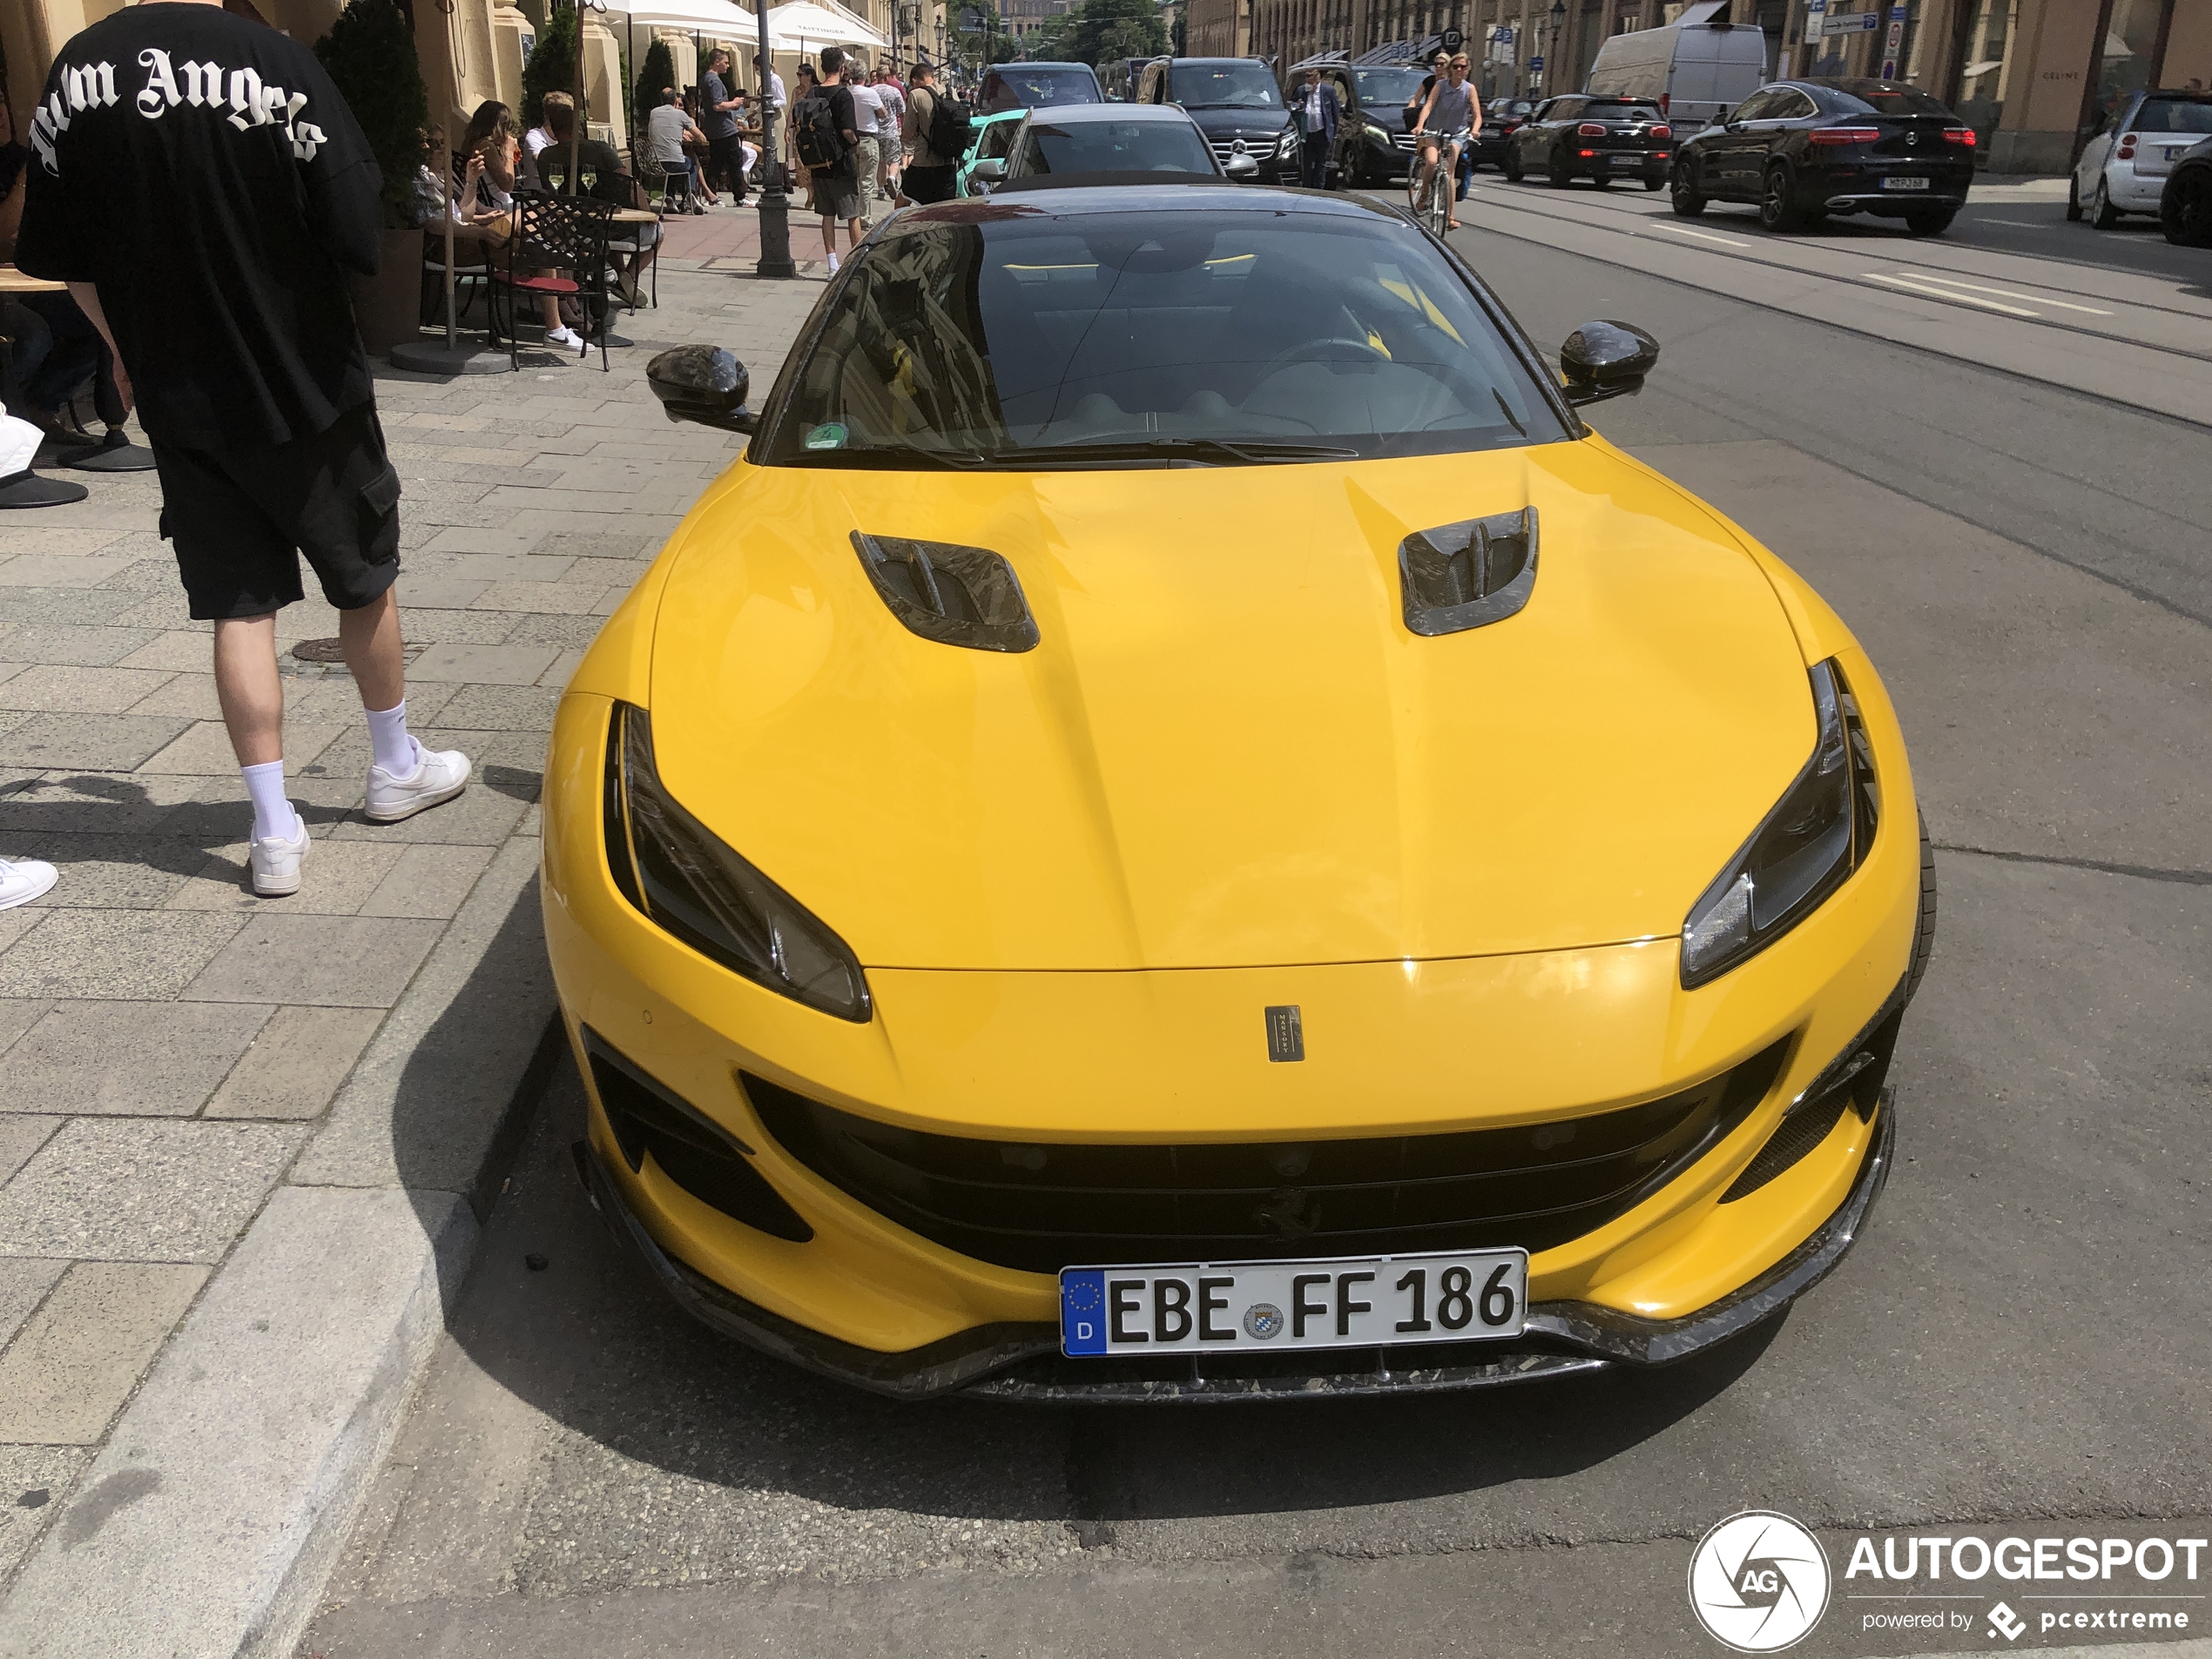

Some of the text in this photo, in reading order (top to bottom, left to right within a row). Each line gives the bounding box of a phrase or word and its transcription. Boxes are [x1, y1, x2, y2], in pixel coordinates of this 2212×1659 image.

[798, 25, 846, 35] TAITTINGER
[137, 48, 328, 163] Angels
[1279, 1015, 1289, 1053] MANSORY
[1077, 1263, 1514, 1343] D EBE FF 186
